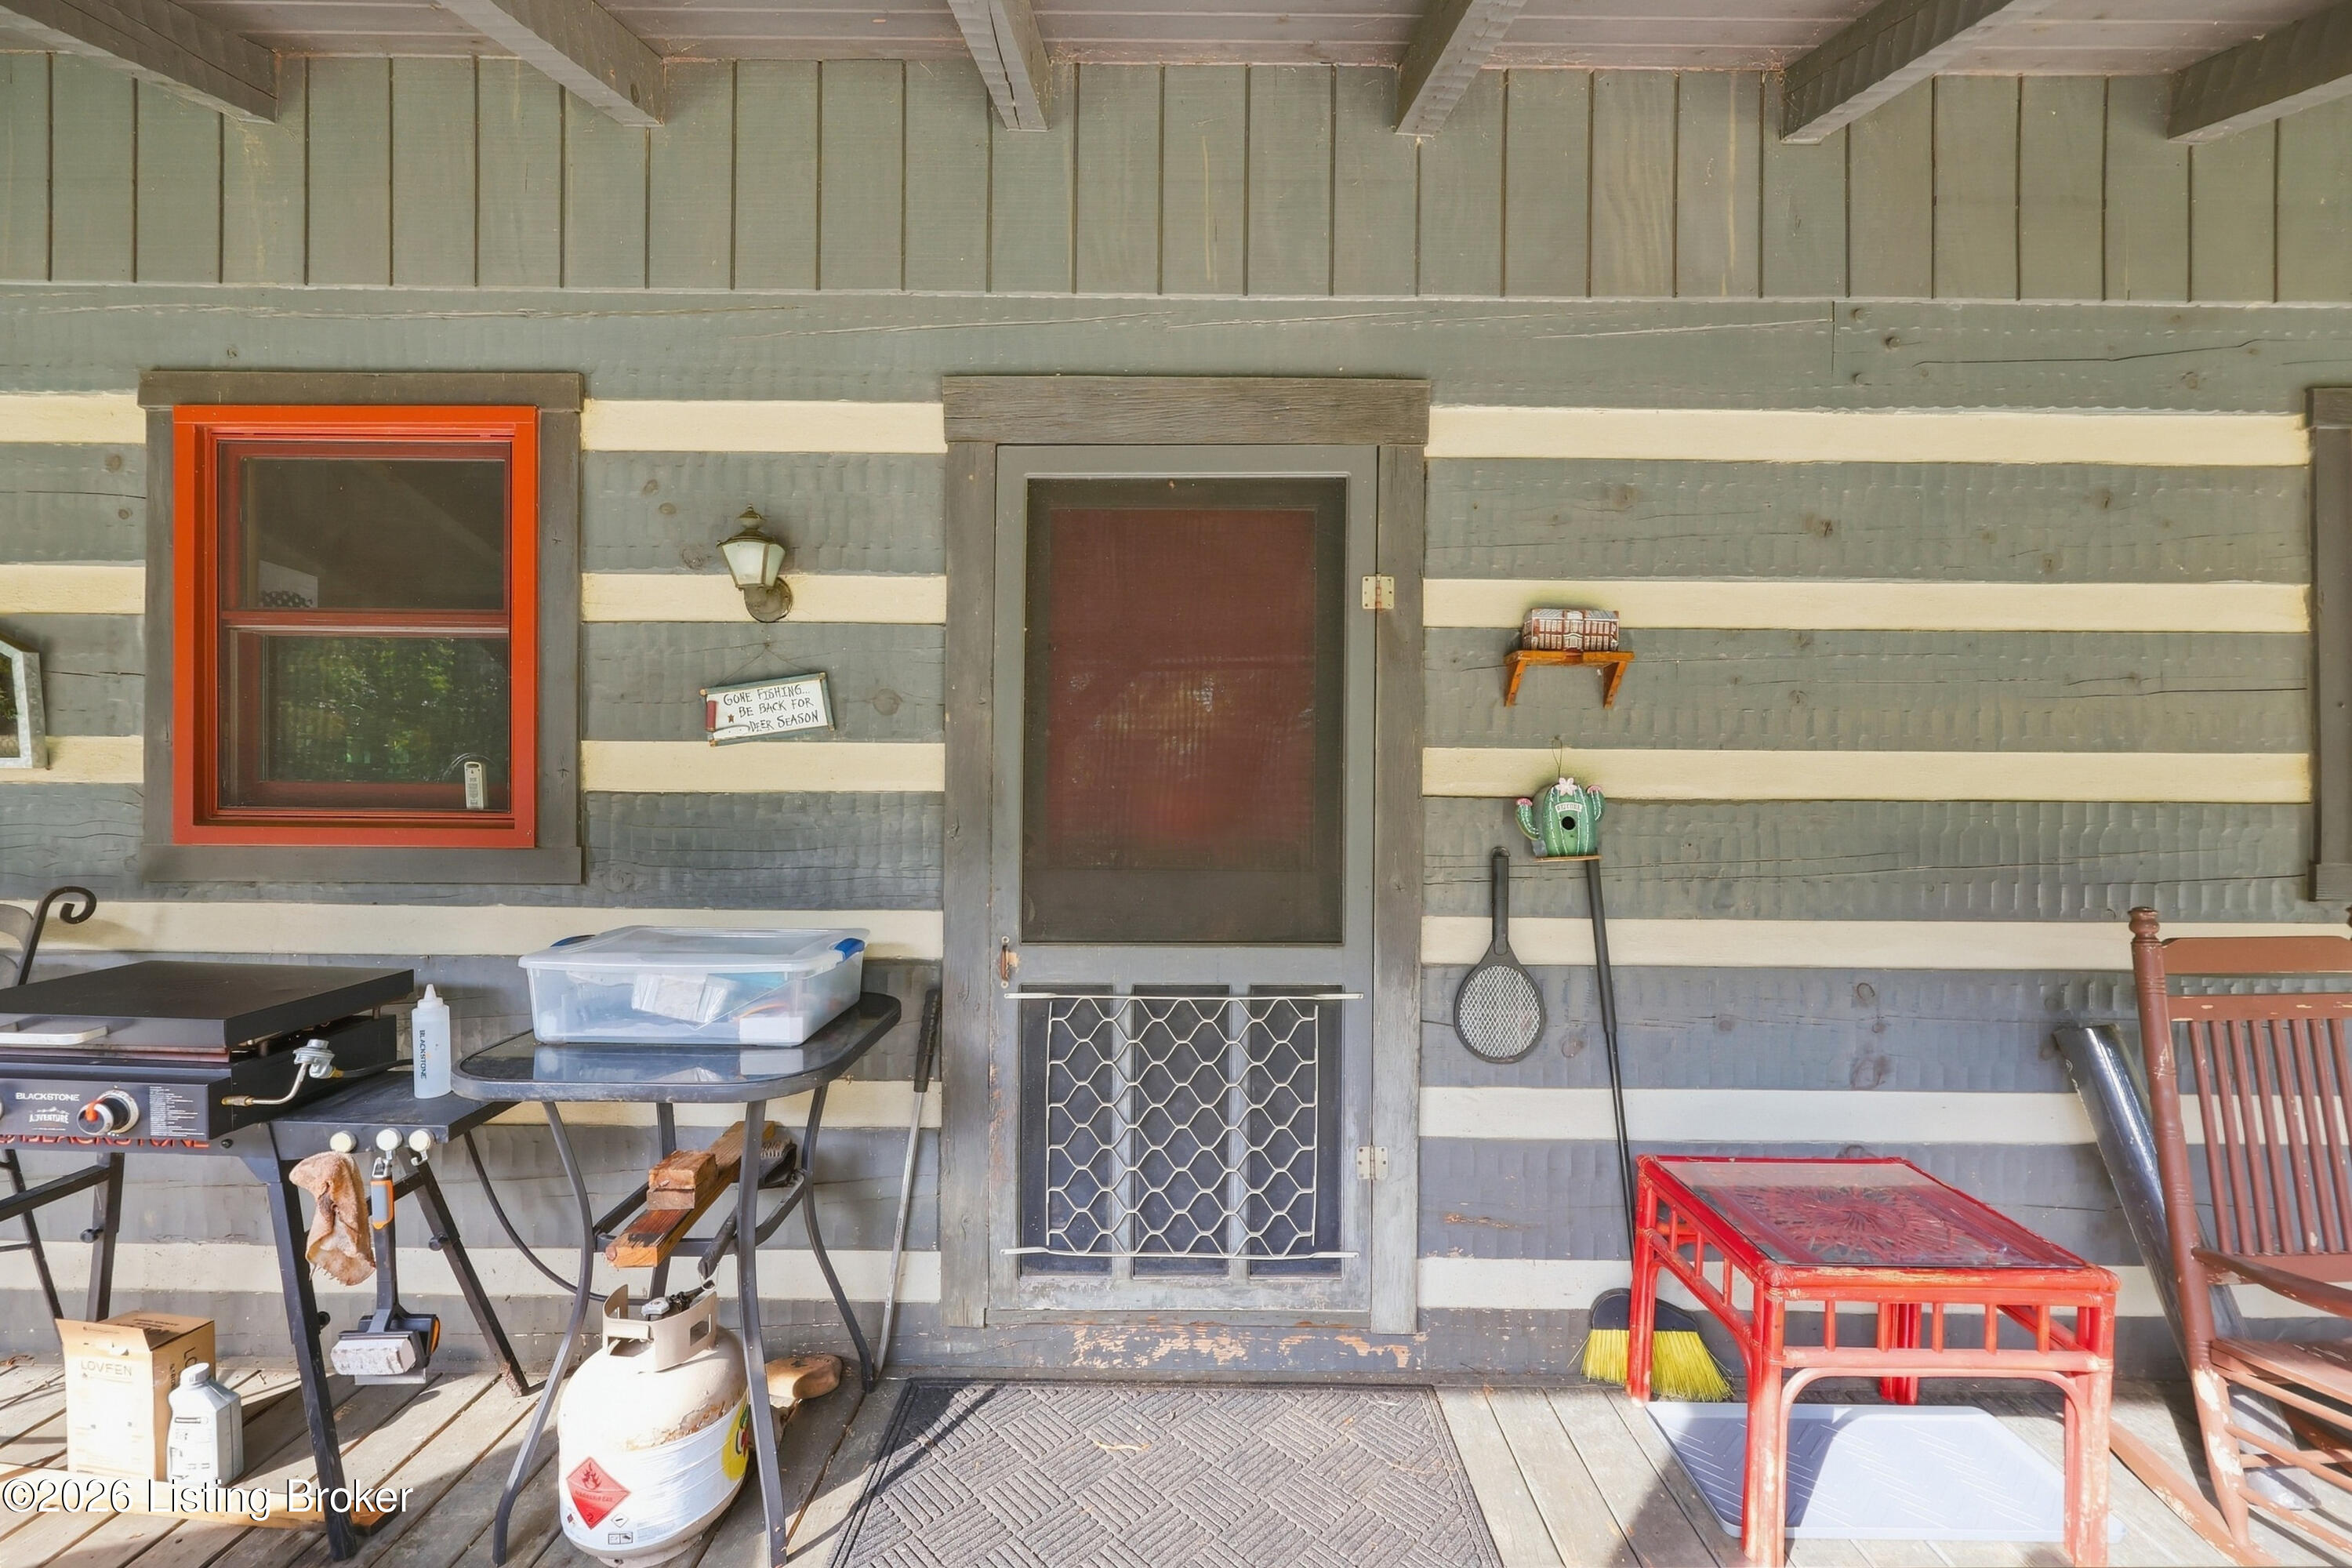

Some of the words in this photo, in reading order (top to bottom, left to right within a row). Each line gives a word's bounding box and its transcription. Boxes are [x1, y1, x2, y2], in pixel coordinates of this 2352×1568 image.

[723, 691, 753, 706] GONE
[739, 706, 754, 718] BE
[758, 701, 786, 714] BACK
[791, 697, 814, 710] FOR
[749, 720, 775, 733] DEER
[776, 710, 819, 728] SEASON
[419, 1029, 427, 1080] BLACKSTONE
[16, 1092, 80, 1102] BLACKSTONE
